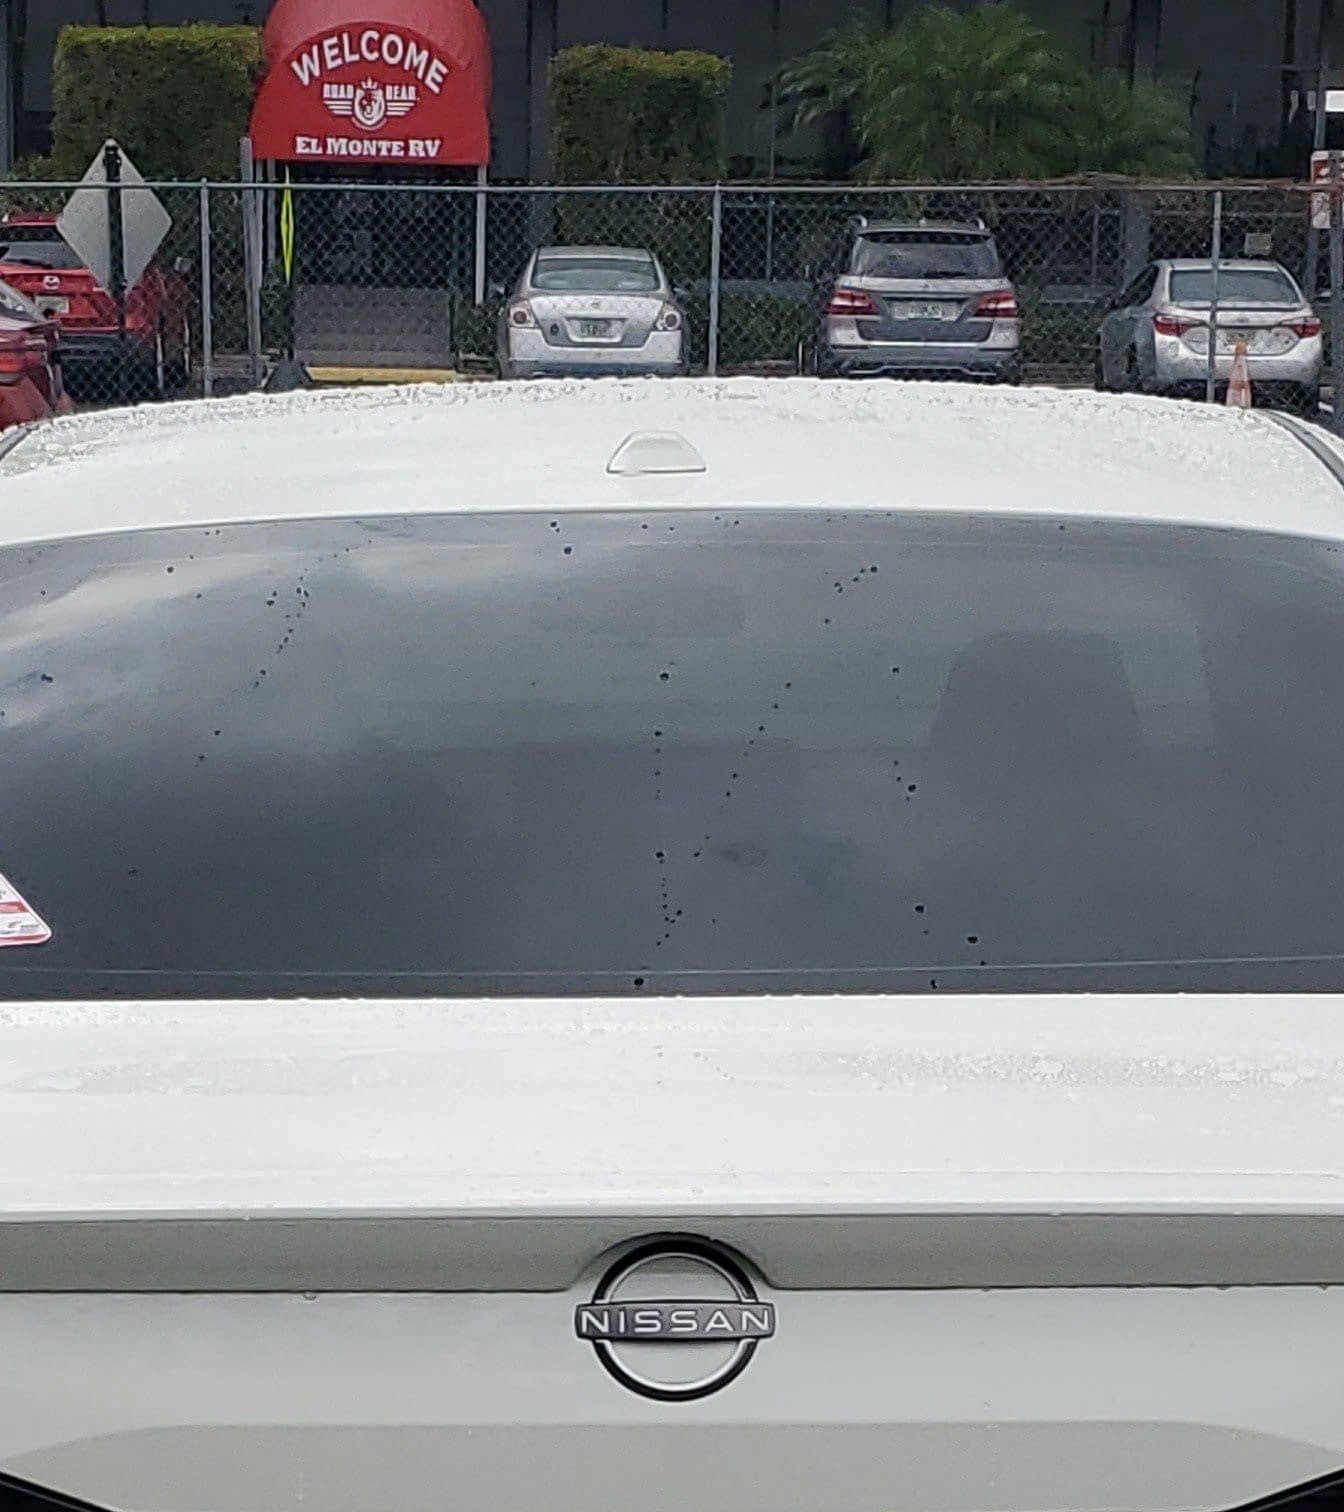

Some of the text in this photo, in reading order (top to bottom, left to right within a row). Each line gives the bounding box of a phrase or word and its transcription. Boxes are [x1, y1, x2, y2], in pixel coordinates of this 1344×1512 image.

[290, 29, 450, 95] WELCOME
[295, 136, 442, 158] EL MONTE RV
[580, 1310, 770, 1333] NISSAN
